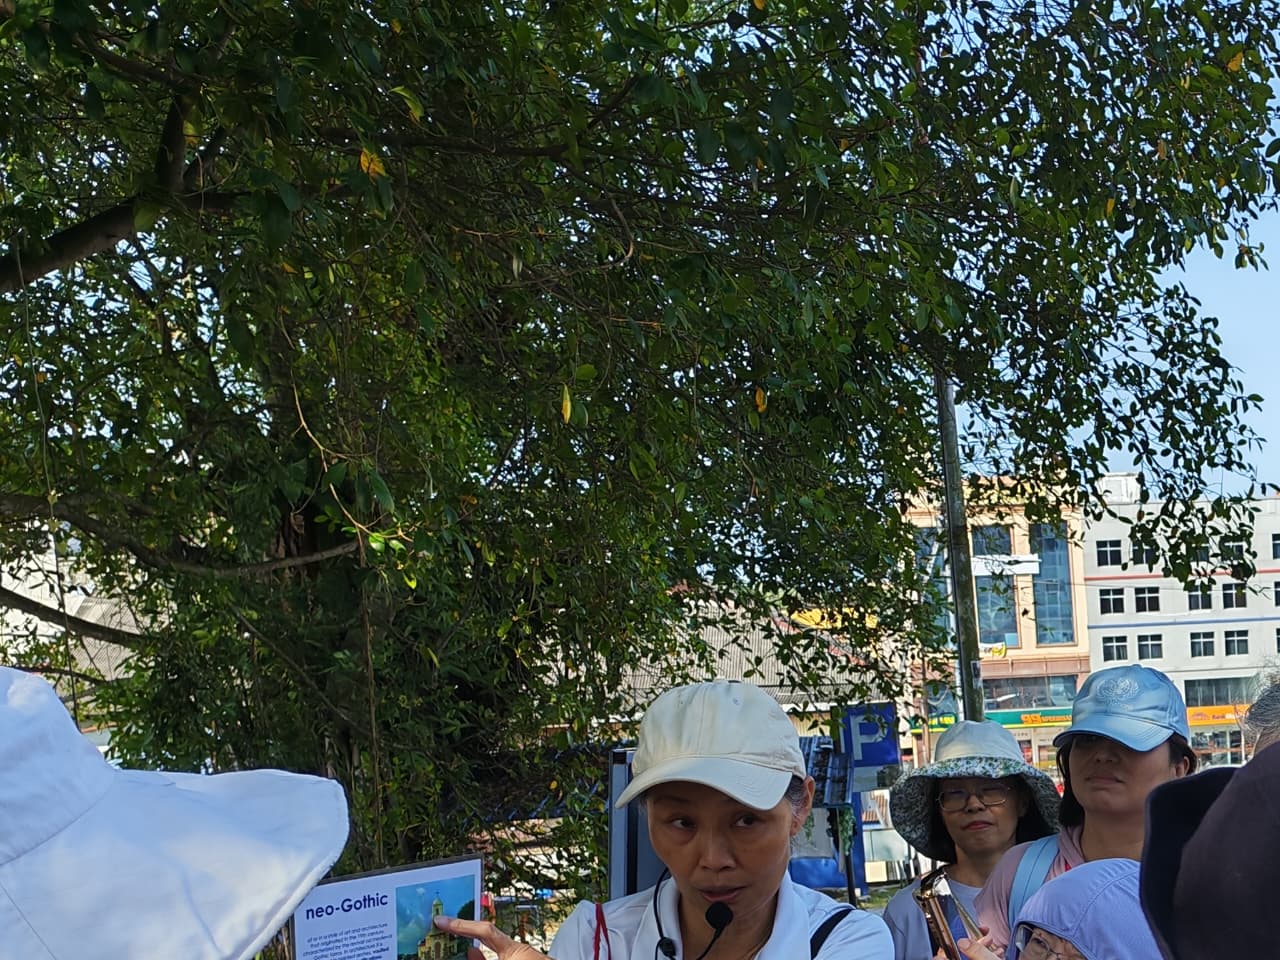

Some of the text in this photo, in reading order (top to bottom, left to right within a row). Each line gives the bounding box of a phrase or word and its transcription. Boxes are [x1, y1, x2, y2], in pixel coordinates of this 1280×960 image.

[1021, 713, 1041, 724] 99
[850, 714, 887, 761] P
[306, 893, 388, 920] neo-Gothic
